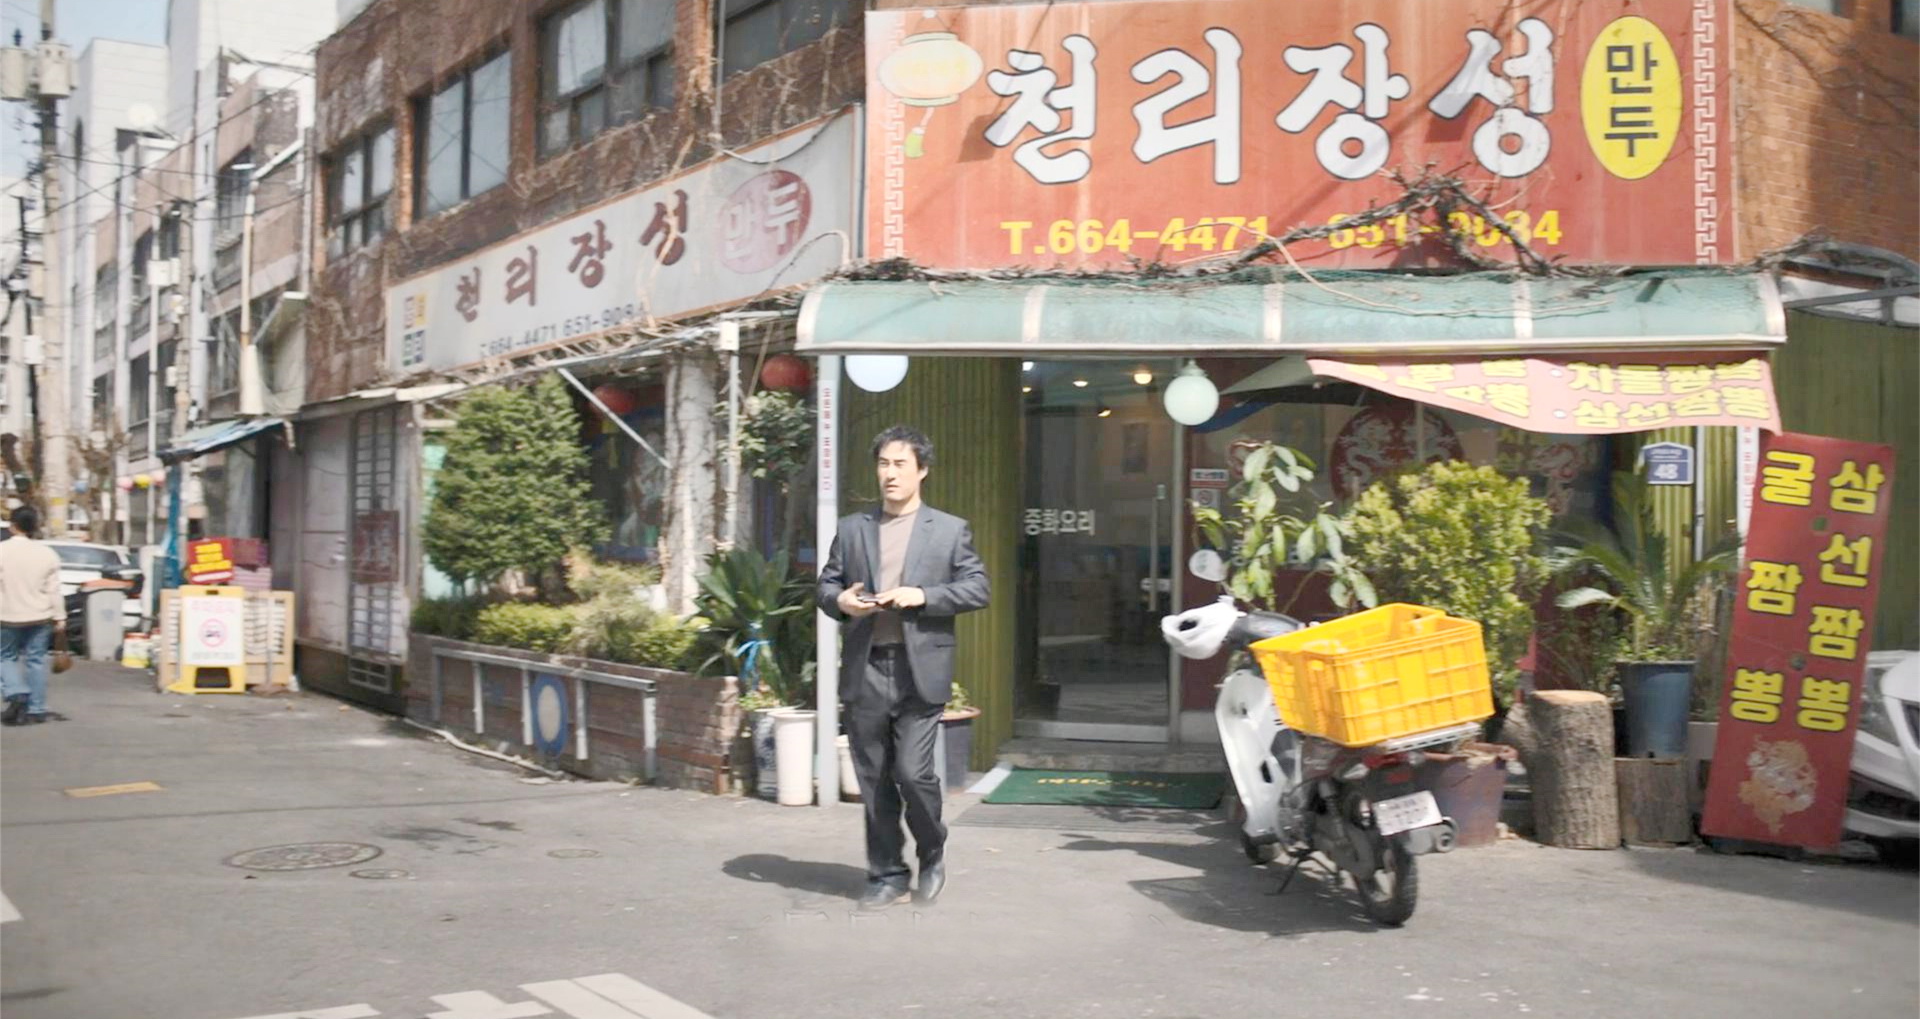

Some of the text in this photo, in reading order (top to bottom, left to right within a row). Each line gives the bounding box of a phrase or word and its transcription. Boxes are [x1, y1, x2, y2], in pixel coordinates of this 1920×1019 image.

[984, 18, 1557, 186] 천리장성
[1603, 41, 1661, 158] 만두
[454, 189, 689, 323] 천리장성
[1000, 215, 1269, 255] T.664-4471
[1024, 508, 1096, 536] 중화요리
[1653, 463, 1679, 480] 48
[1730, 450, 1816, 724] 굴짬뽕
[1797, 460, 1885, 733] 삼선짬뽕
